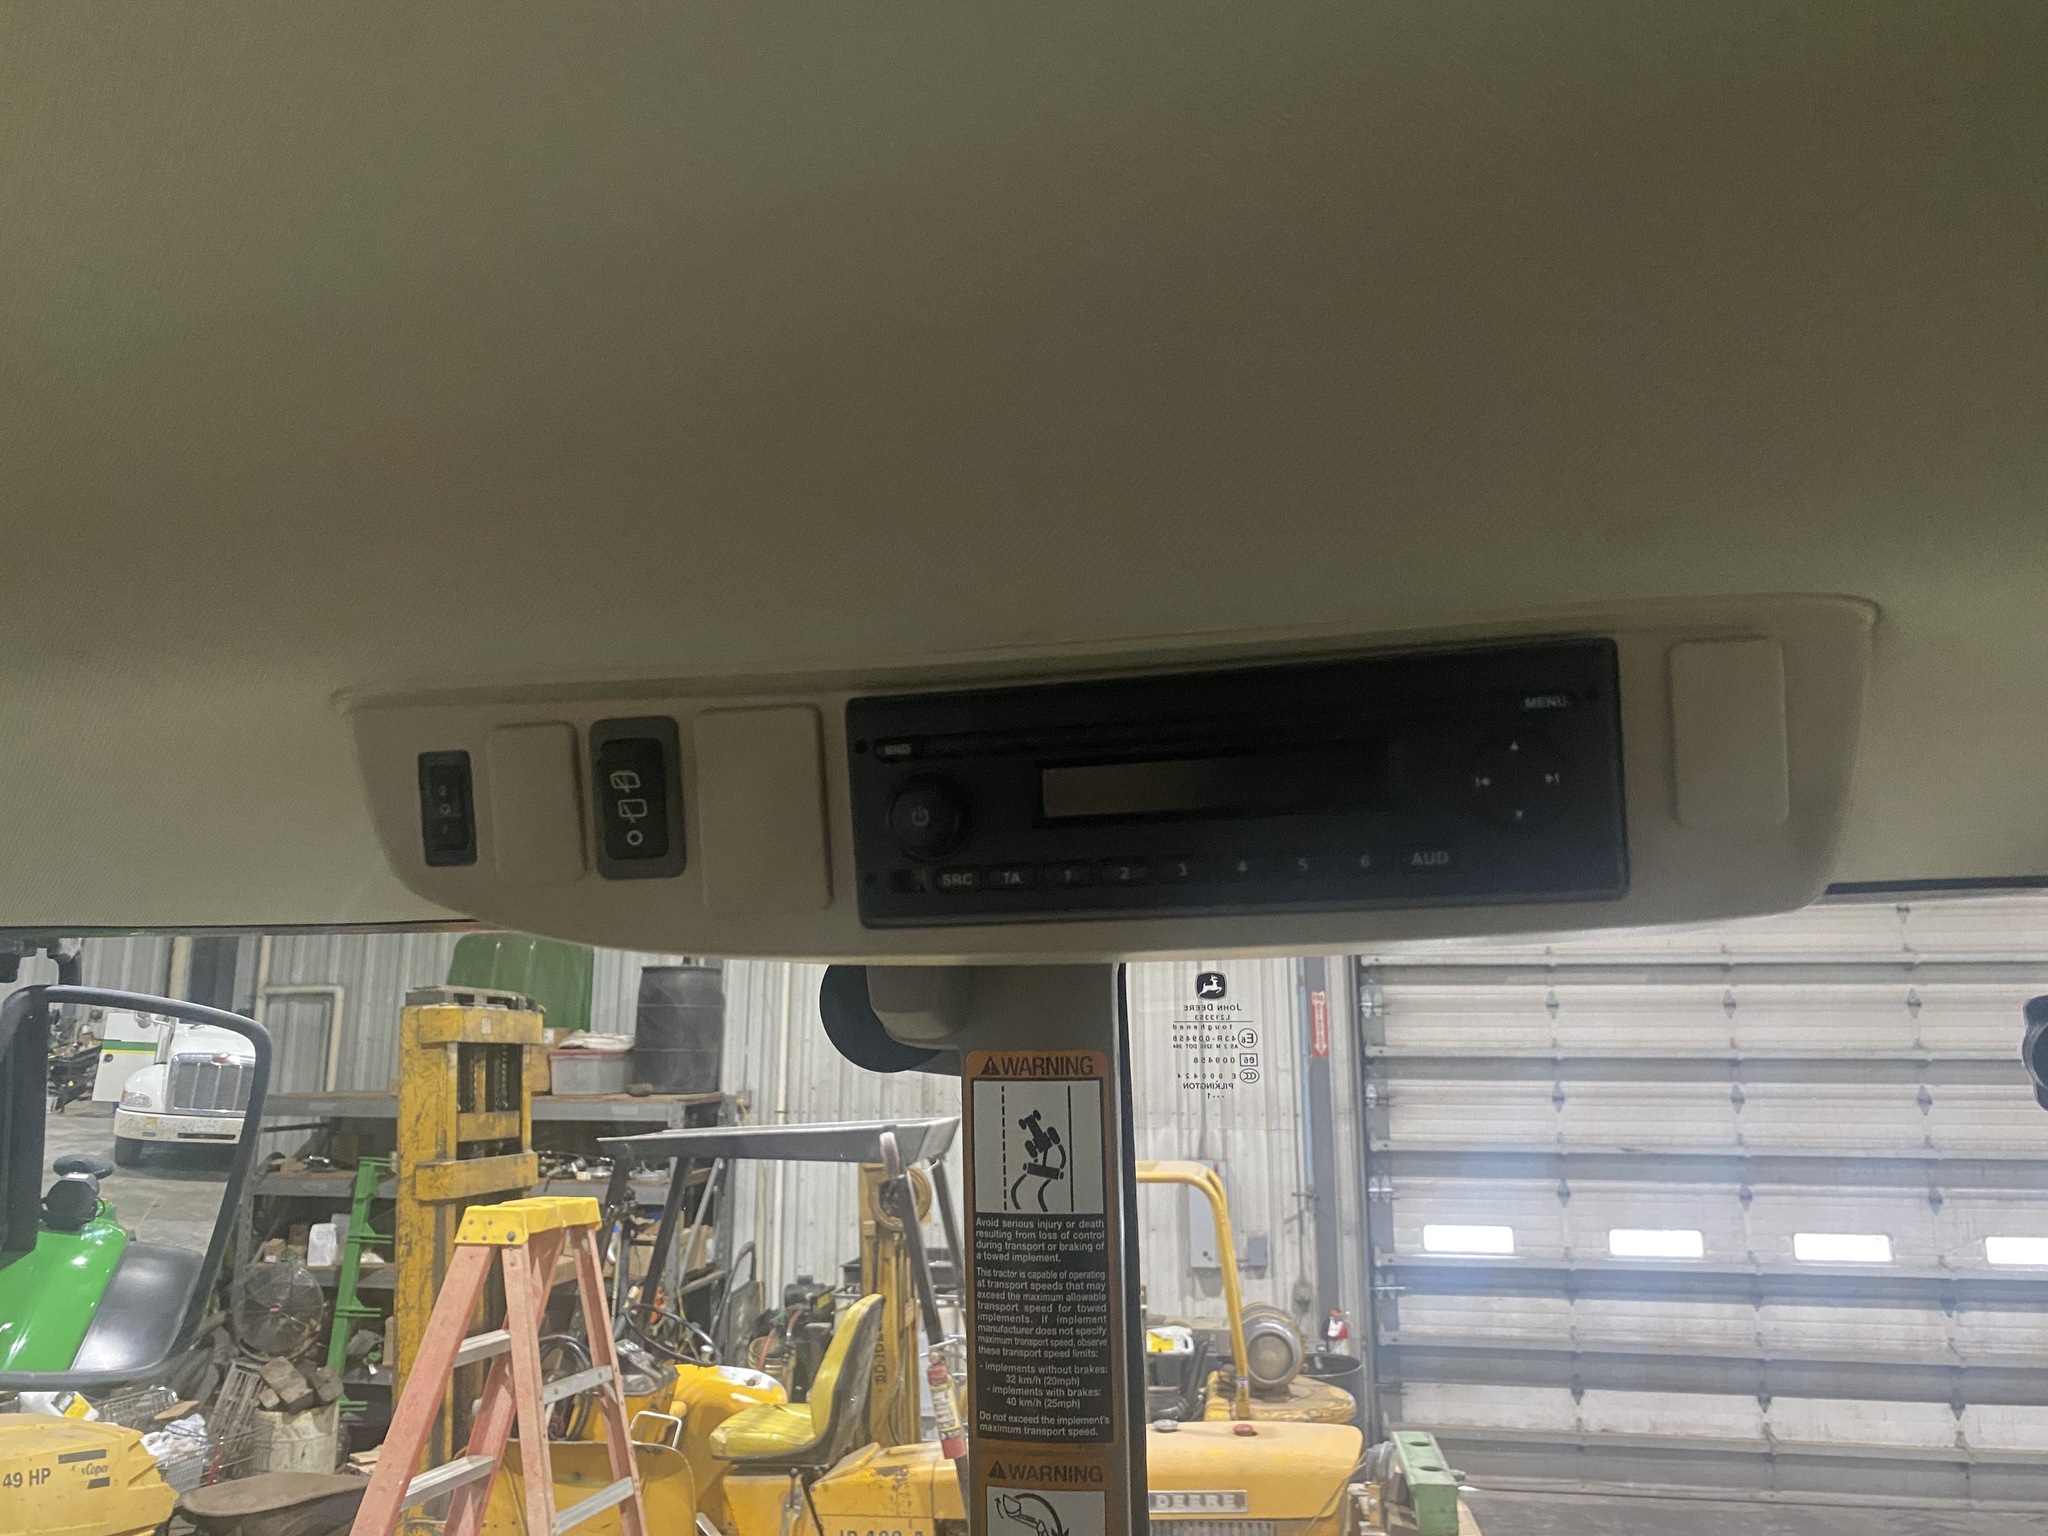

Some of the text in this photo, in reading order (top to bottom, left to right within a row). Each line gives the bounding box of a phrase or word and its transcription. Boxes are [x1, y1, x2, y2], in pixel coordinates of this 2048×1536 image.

[1524, 696, 1568, 710] MENU
[942, 872, 973, 887] SRC
[1119, 866, 1129, 879] 2
[1178, 863, 1188, 876] 3
[1236, 860, 1247, 872] 4
[1298, 858, 1308, 871] 5
[1360, 854, 1370, 867] 6
[1411, 850, 1449, 866] AUD
[1001, 1056, 1093, 1076] WARNING
[976, 1217, 998, 1227] Avoid
[1002, 1218, 1034, 1228] serious
[1038, 1220, 1062, 1230] injury
[1078, 1220, 1104, 1228] death
[976, 1229, 1012, 1240] resulting
[1016, 1231, 1036, 1239] from
[1039, 1231, 1058, 1240] loss
[1061, 1231, 1070, 1240] of
[976, 1241, 1002, 1251] during
[1005, 1242, 1045, 1251] transport
[1060, 1242, 1092, 1252] braking
[1096, 1242, 1105, 1250] of
[984, 1252, 1009, 1260] towed
[1012, 1254, 1061, 1263] implement.
[977, 1267, 1106, 1280] This tractor is capable of operating
[988, 1280, 1028, 1290] transport
[1030, 1282, 1063, 1291] speeds
[1066, 1282, 1084, 1290] that
[1087, 1283, 1106, 1292] may
[977, 1290, 1106, 1301] exceed the maximum allowable
[977, 1301, 1106, 1314] transport speed for towed
[978, 1312, 1107, 1325] implements. If implement
[978, 1324, 1107, 1336] manufacturer does not specify
[978, 1335, 1108, 1348] maximum transport speed, observe
[978, 1346, 1098, 1358] these transport speed limits:
[985, 1362, 1036, 1373] implements
[1038, 1365, 1072, 1374] without
[1074, 1365, 1108, 1374] brakes:
[1006, 1374, 1080, 1387] 32 km/h (20mph)
[992, 1386, 1043, 1396] implements
[1046, 1388, 1065, 1396] with
[1068, 1388, 1101, 1397] brakes:
[1006, 1398, 1080, 1409] 40 km/h (25mph)
[980, 1411, 1110, 1426] Do not exceed the implement's
[980, 1424, 1098, 1437] maximum transport speed.
[2, 1472, 23, 1488] 49
[29, 1468, 51, 1486] HP
[1008, 1464, 1103, 1482] WARNING
[1155, 1494, 1235, 1509] DEERE
